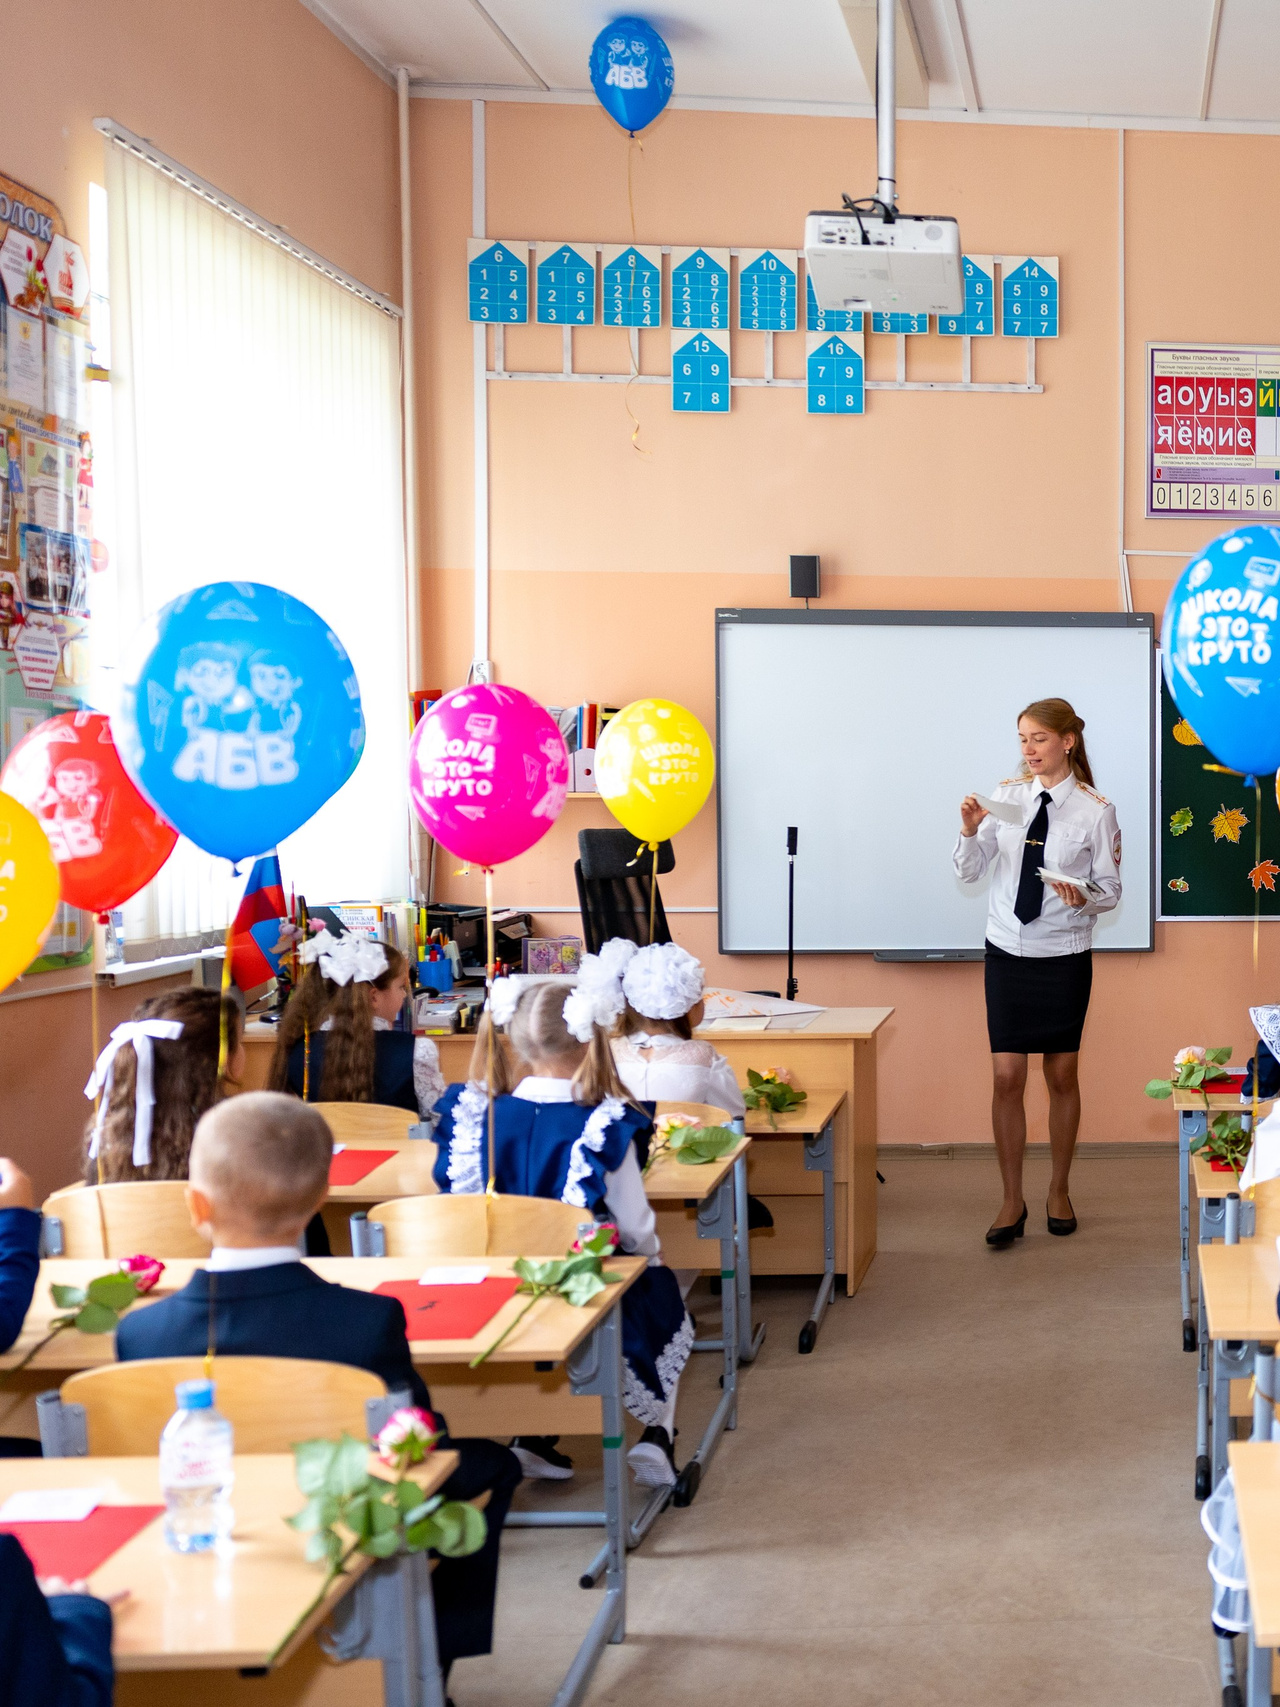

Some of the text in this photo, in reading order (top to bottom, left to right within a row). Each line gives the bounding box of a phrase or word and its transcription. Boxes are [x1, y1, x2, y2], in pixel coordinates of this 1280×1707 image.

[605, 64, 648, 90] АБВ
[495, 250, 503, 262] 6
[562, 253, 570, 264] 7
[628, 255, 636, 268] 8
[696, 257, 704, 269] 9
[761, 259, 776, 271] 10
[1023, 266, 1038, 278] 14
[693, 340, 709, 352] 15
[828, 343, 844, 355] 16
[683, 364, 719, 376] 6 9
[818, 366, 853, 378] 7 9
[683, 392, 719, 404] 7 8
[818, 394, 854, 406] 8 8
[1157, 487, 1165, 504] 0
[1177, 488, 1181, 504] 1
[1193, 488, 1201, 505] 2
[1210, 488, 1219, 505] 3
[1228, 489, 1236, 505] 4
[1246, 489, 1254, 506] 5
[1263, 490, 1272, 506] 6
[1179, 587, 1279, 628] ШКОЛА
[1187, 641, 1272, 666] КРУТО
[640, 742, 700, 761] ШКОЛА
[171, 728, 300, 791] АБВ
[648, 770, 699, 786] КРУТО
[422, 778, 493, 798] КРУТО
[40, 819, 103, 863] БВ
